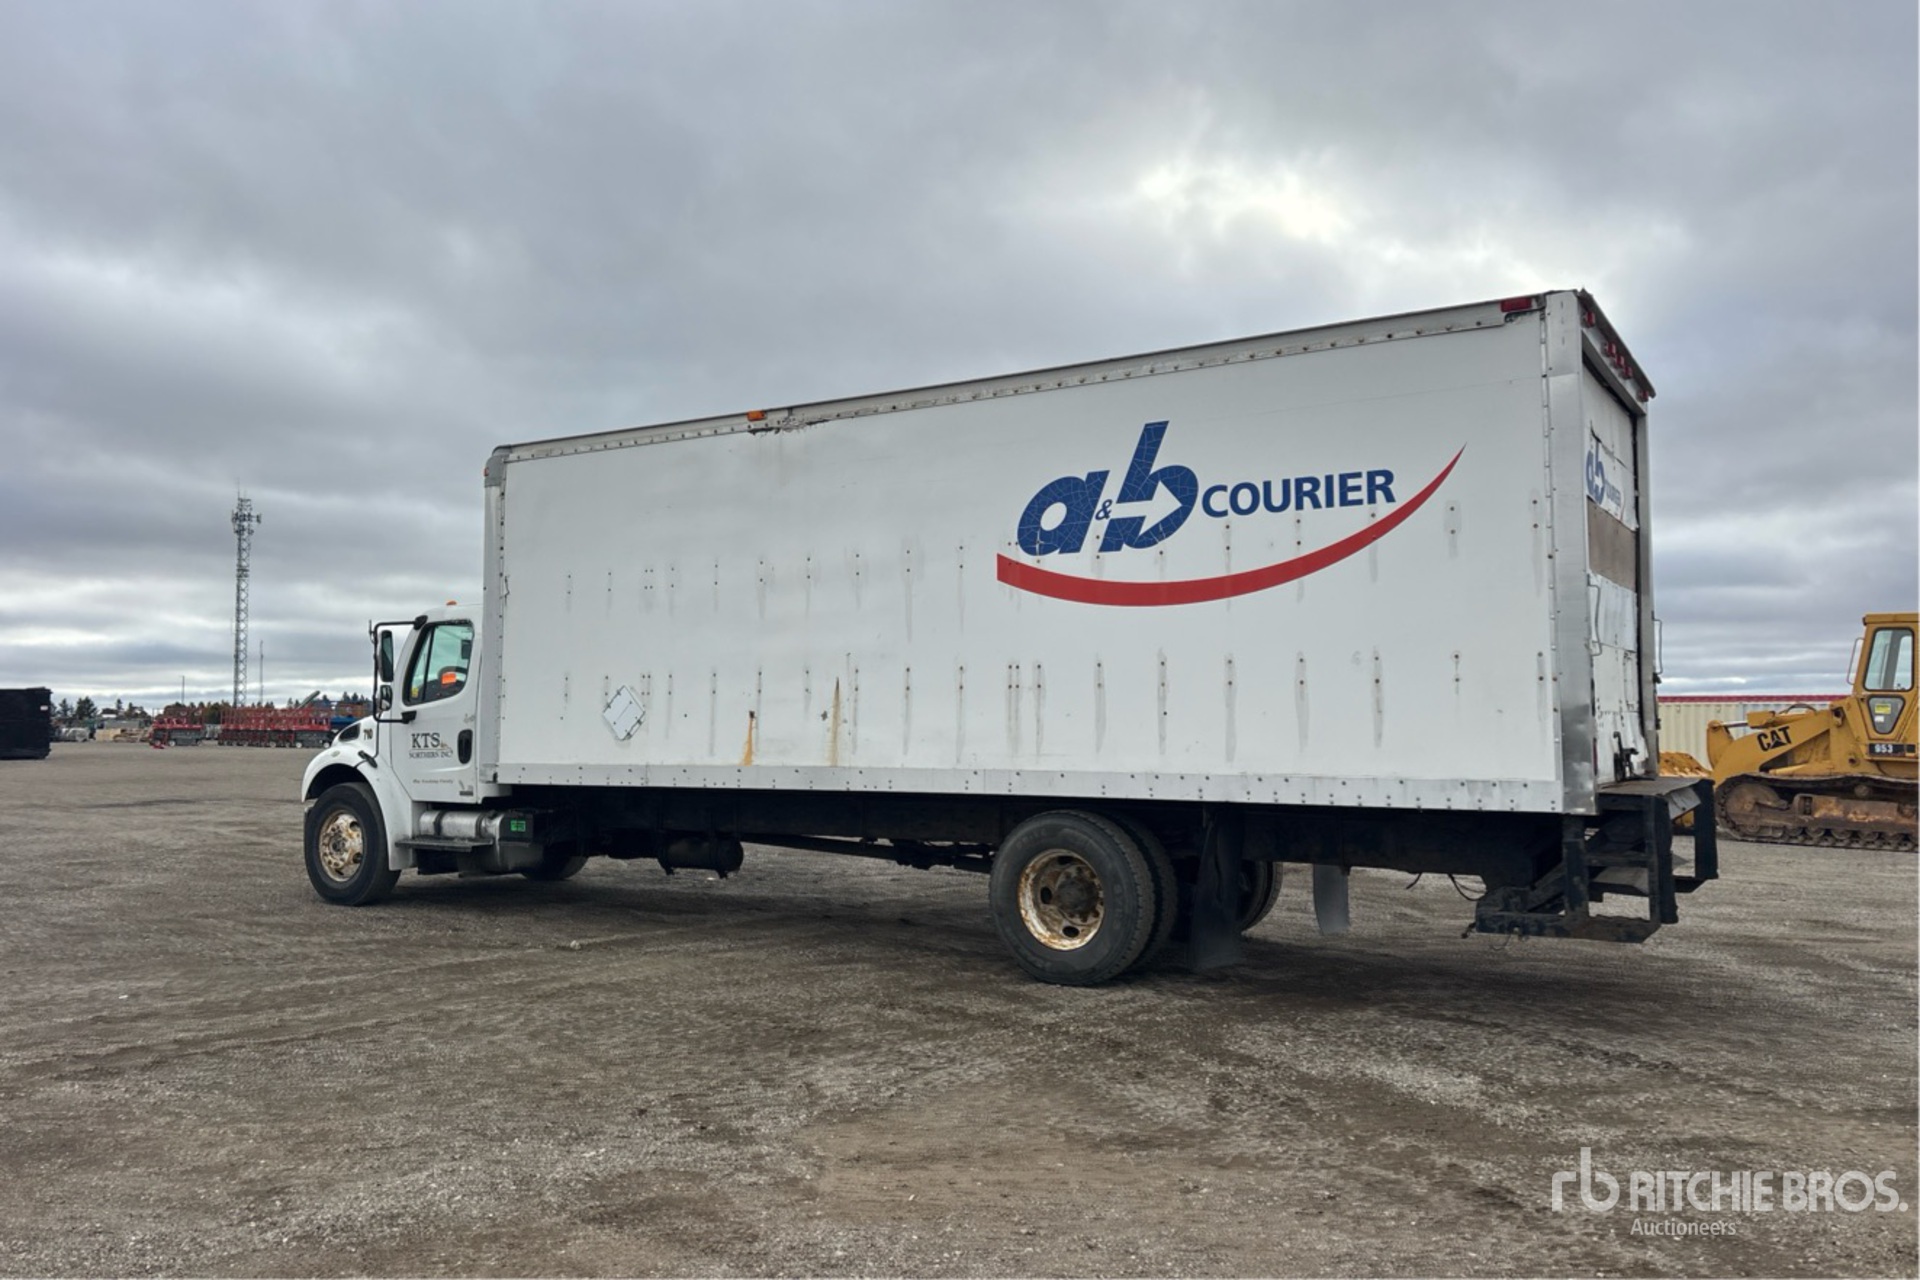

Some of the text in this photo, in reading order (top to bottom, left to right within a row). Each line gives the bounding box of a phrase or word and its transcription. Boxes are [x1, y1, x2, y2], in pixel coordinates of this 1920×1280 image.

[1201, 469, 1396, 518] COURIER
[411, 732, 440, 748] KTS
[1757, 725, 1792, 752] CAT
